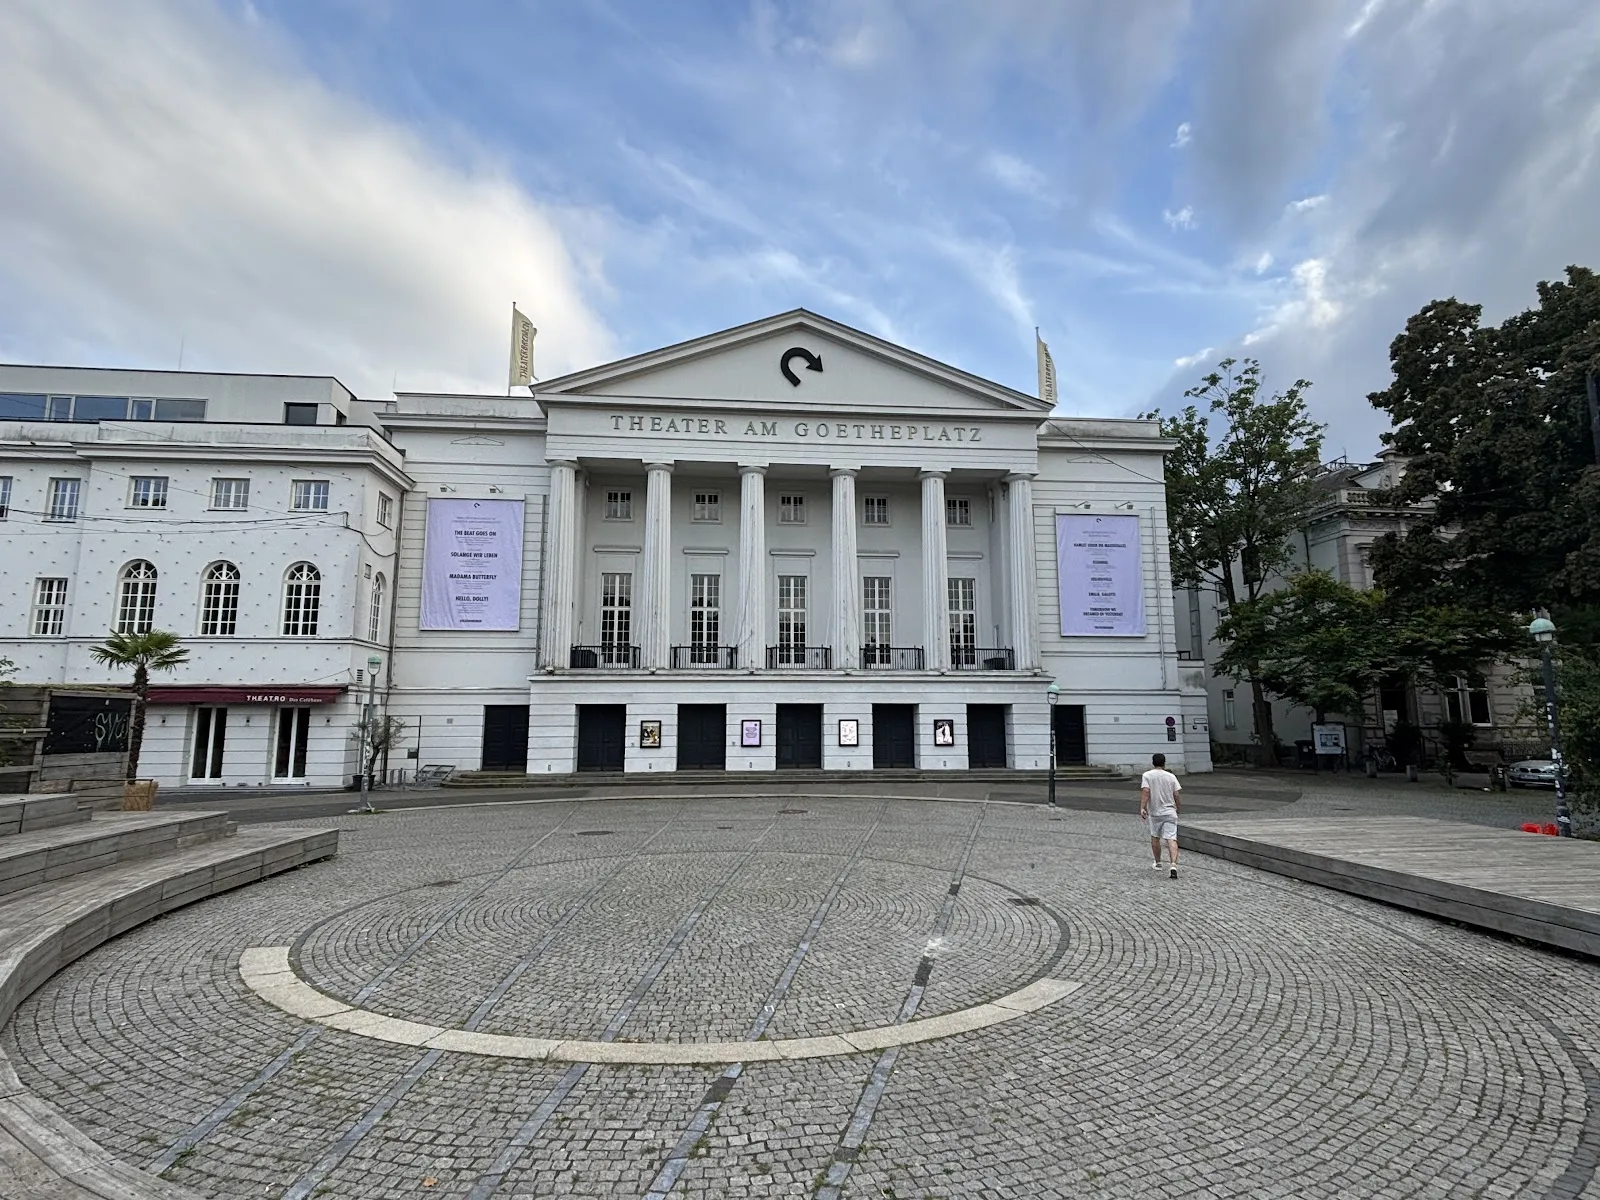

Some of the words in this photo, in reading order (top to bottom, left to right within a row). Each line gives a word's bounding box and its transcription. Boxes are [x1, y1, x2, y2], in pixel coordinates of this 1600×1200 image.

[610, 415, 728, 435] THEATER
[743, 421, 778, 436] AM
[794, 422, 982, 442] GOETHEPLATZ
